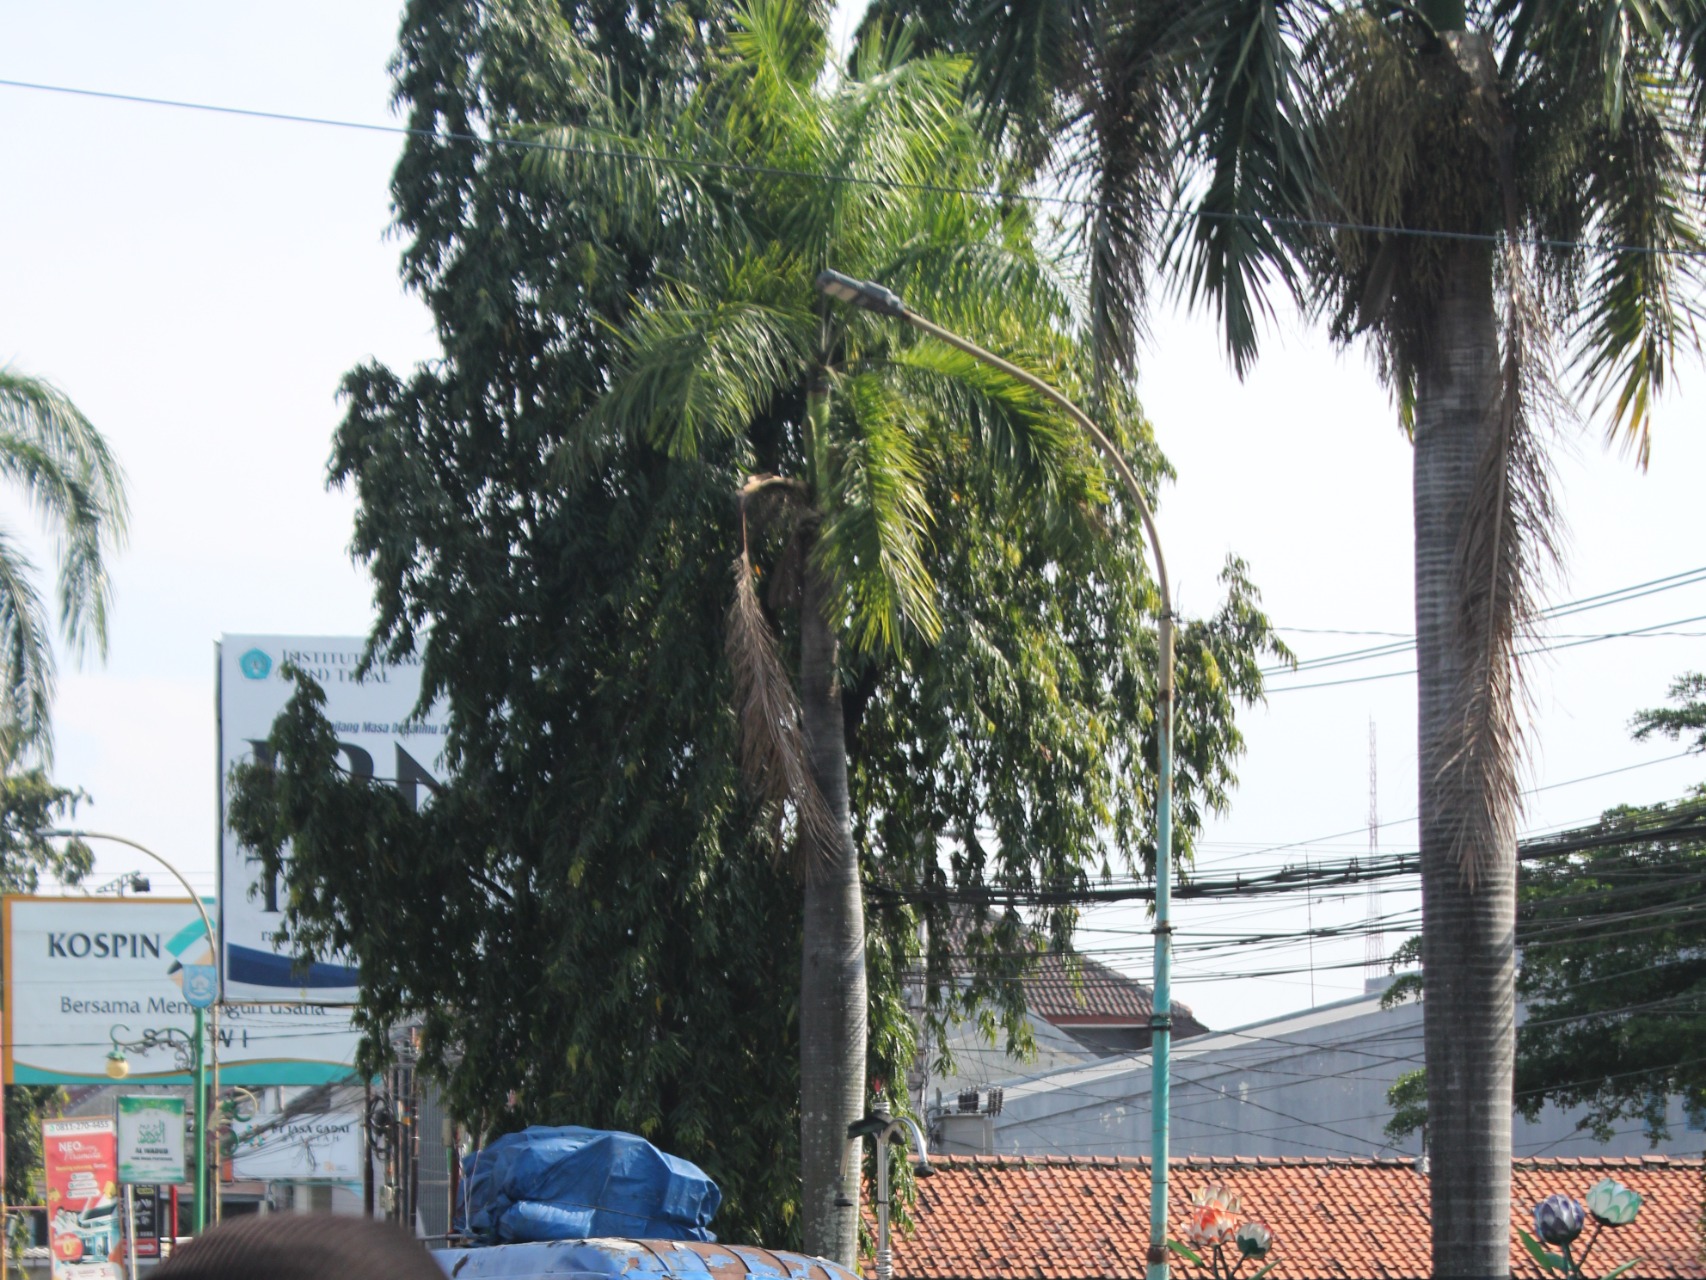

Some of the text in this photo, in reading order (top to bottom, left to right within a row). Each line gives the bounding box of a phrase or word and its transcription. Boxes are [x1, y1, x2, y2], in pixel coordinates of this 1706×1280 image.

[362, 721, 389, 733] Masa
[48, 933, 160, 959] KOSPIN
[60, 996, 141, 1014] Bersama
[146, 997, 262, 1019] Memangun
[58, 1141, 82, 1152] NEO
